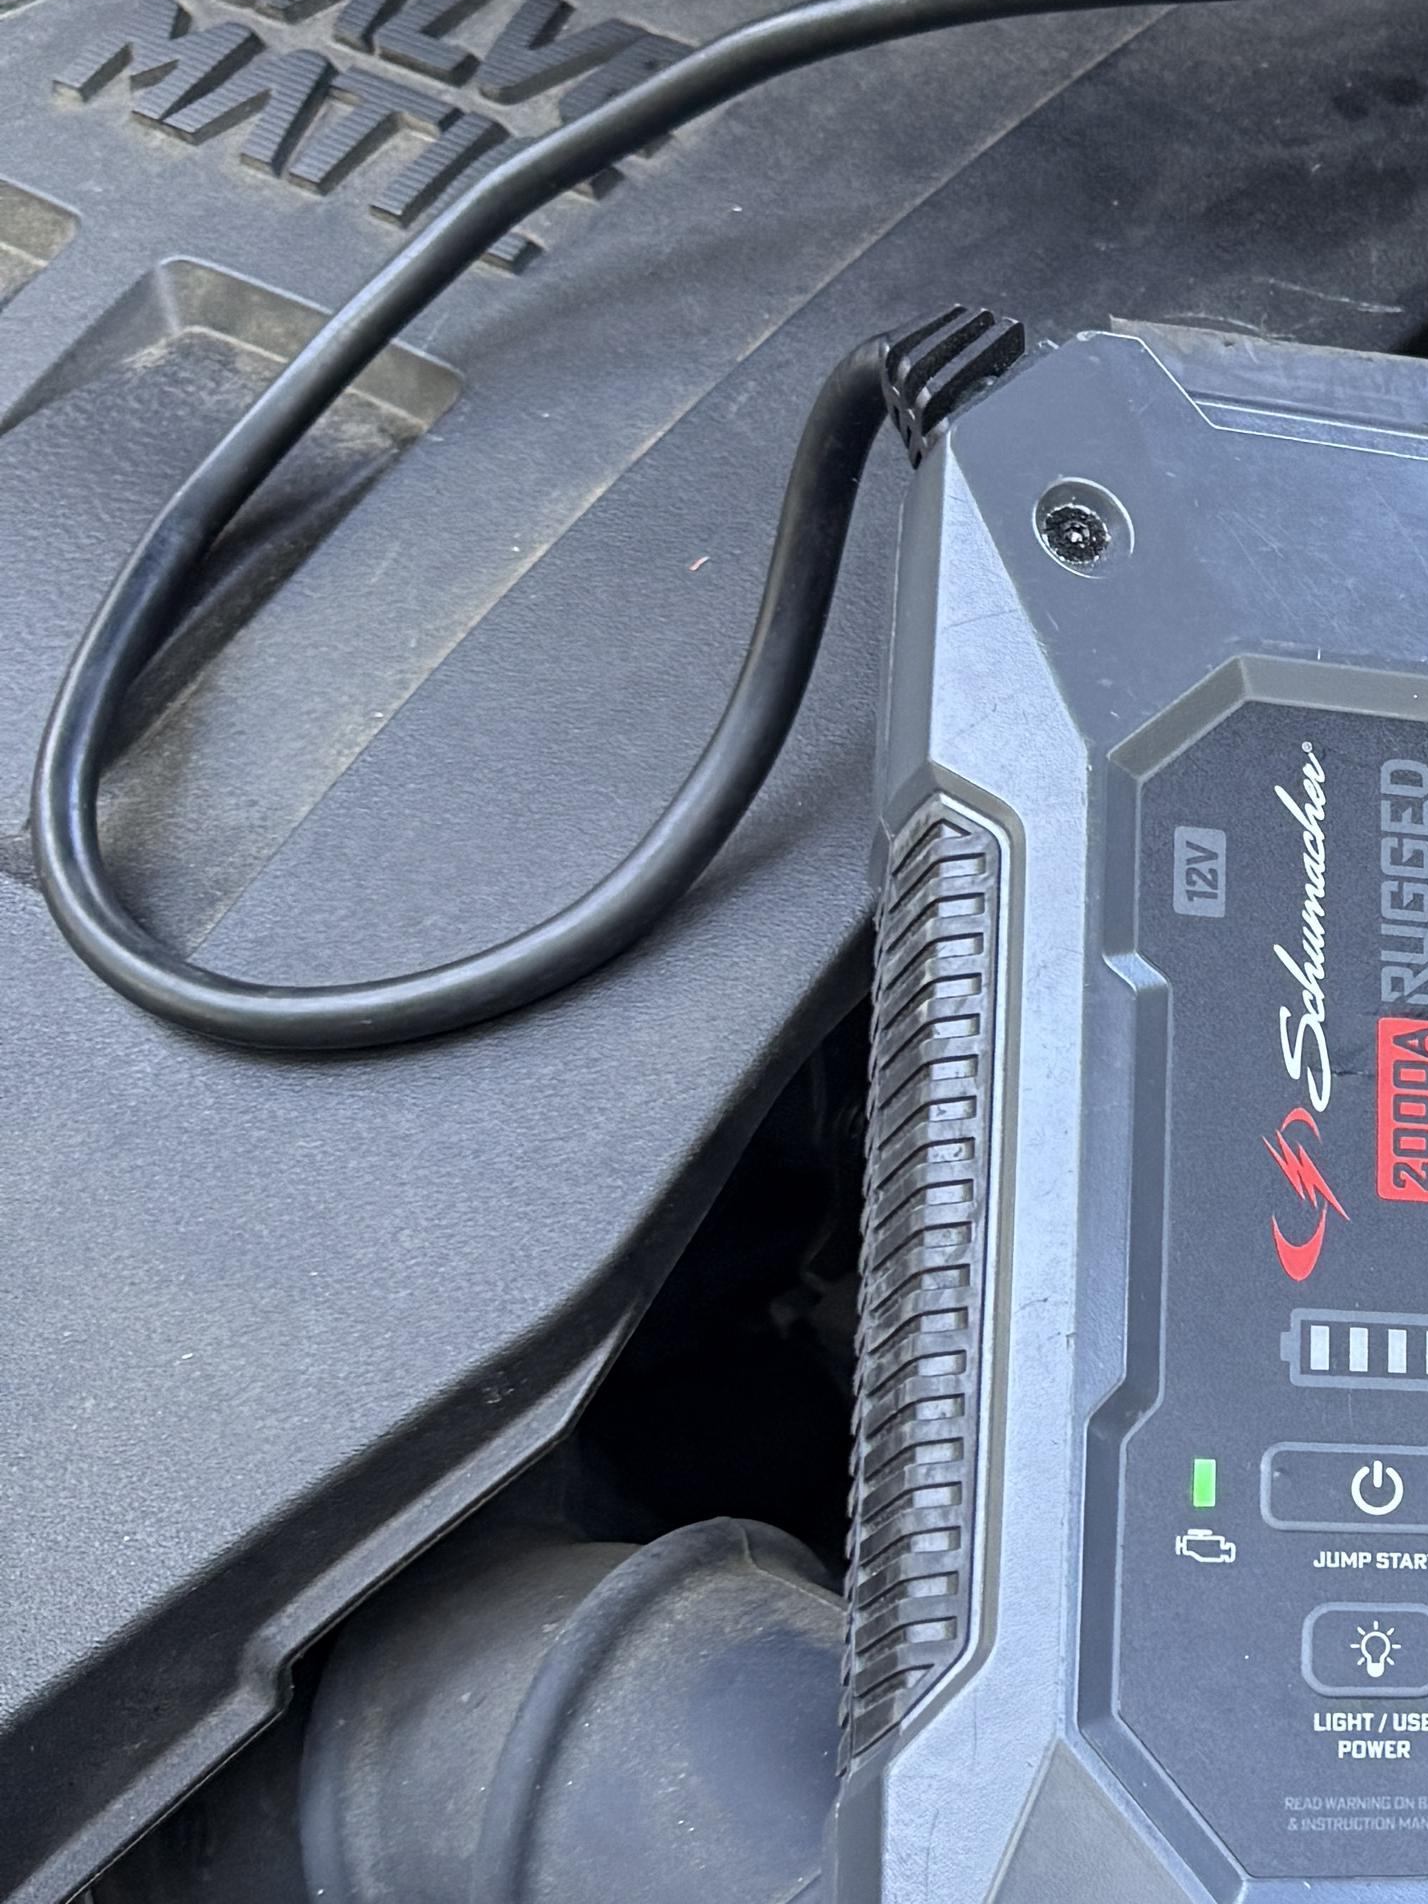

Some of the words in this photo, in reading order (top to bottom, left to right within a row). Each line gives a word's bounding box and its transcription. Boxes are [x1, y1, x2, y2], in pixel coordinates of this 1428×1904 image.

[1186, 841, 1219, 902] 12V
[1313, 1551, 1371, 1569] JUMP
[1313, 1712, 1375, 1732] LIGHT
[1338, 1740, 1411, 1759] POWER
[1284, 1796, 1323, 1811] READ
[1325, 1796, 1391, 1811] WARNING
[1394, 1796, 1415, 1811] ON
[1301, 1817, 1395, 1832] INSTRUCTION
